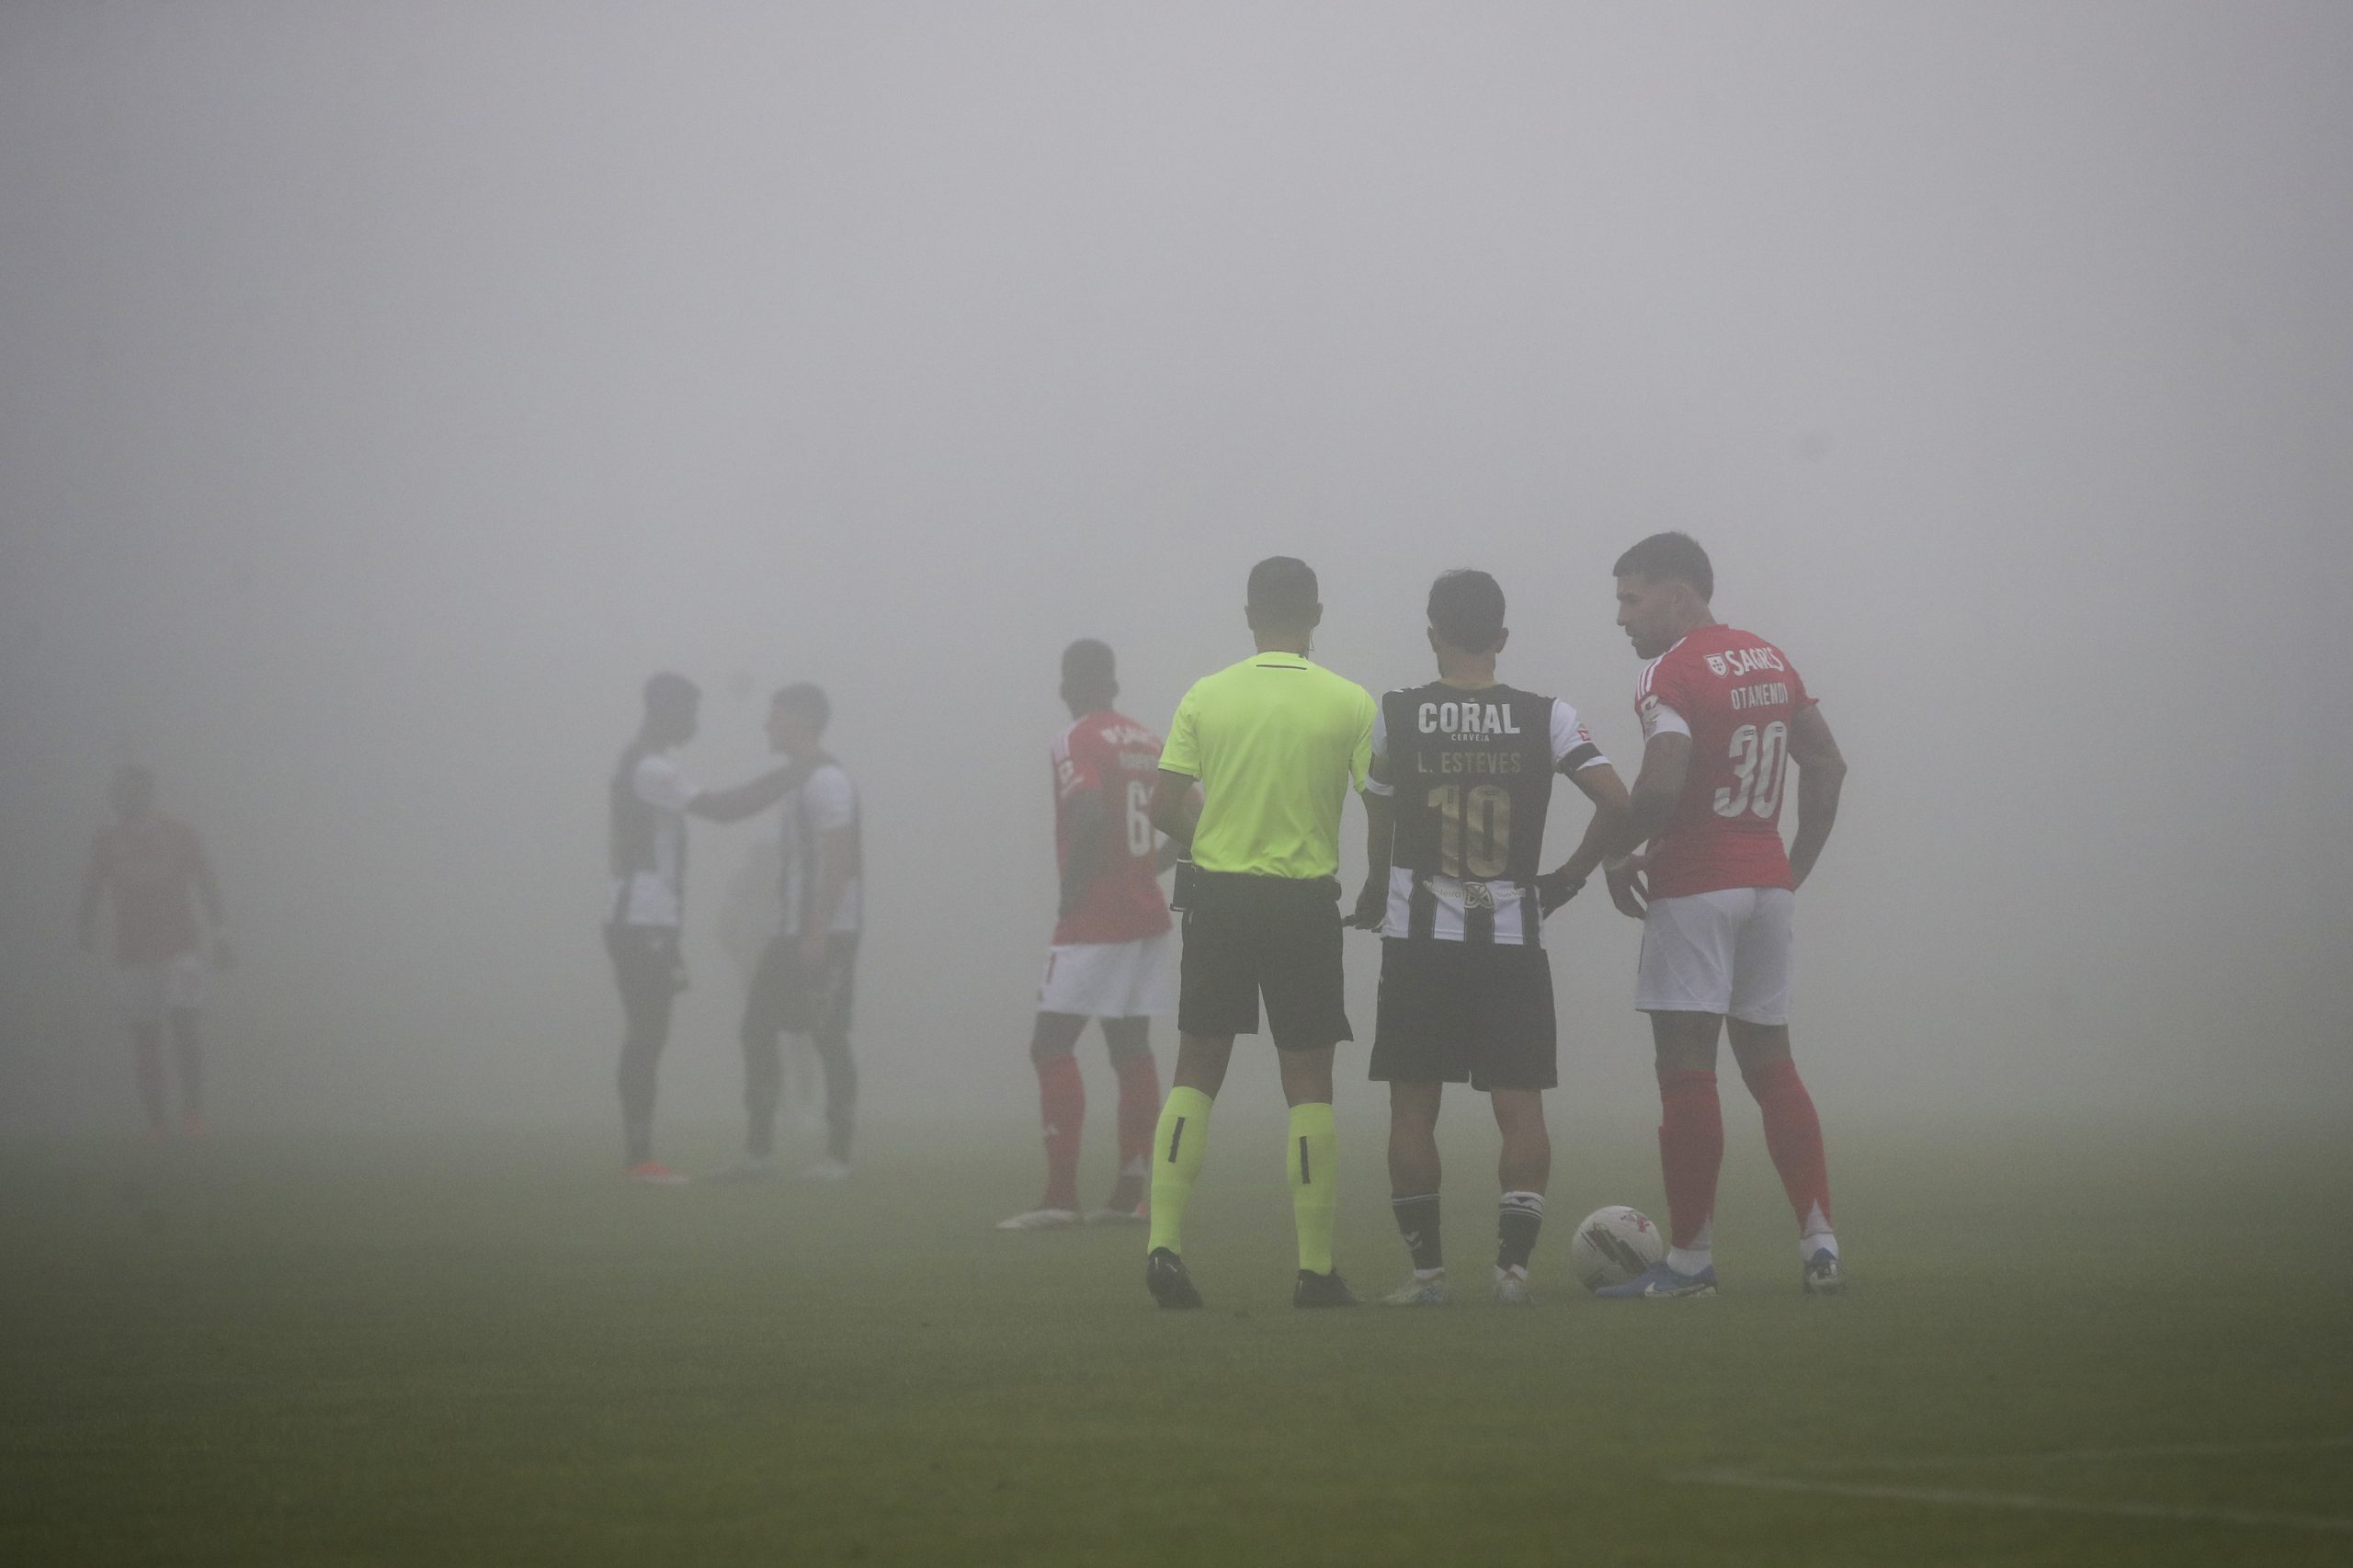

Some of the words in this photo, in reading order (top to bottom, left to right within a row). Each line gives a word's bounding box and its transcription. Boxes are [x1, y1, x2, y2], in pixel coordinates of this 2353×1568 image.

[1418, 701, 1521, 733] CORAL
[1417, 751, 1433, 773] L.
[1440, 751, 1522, 774] ESTEVES
[1713, 722, 1788, 819] 30
[1127, 779, 1154, 857] 6
[1427, 783, 1511, 878] 10
